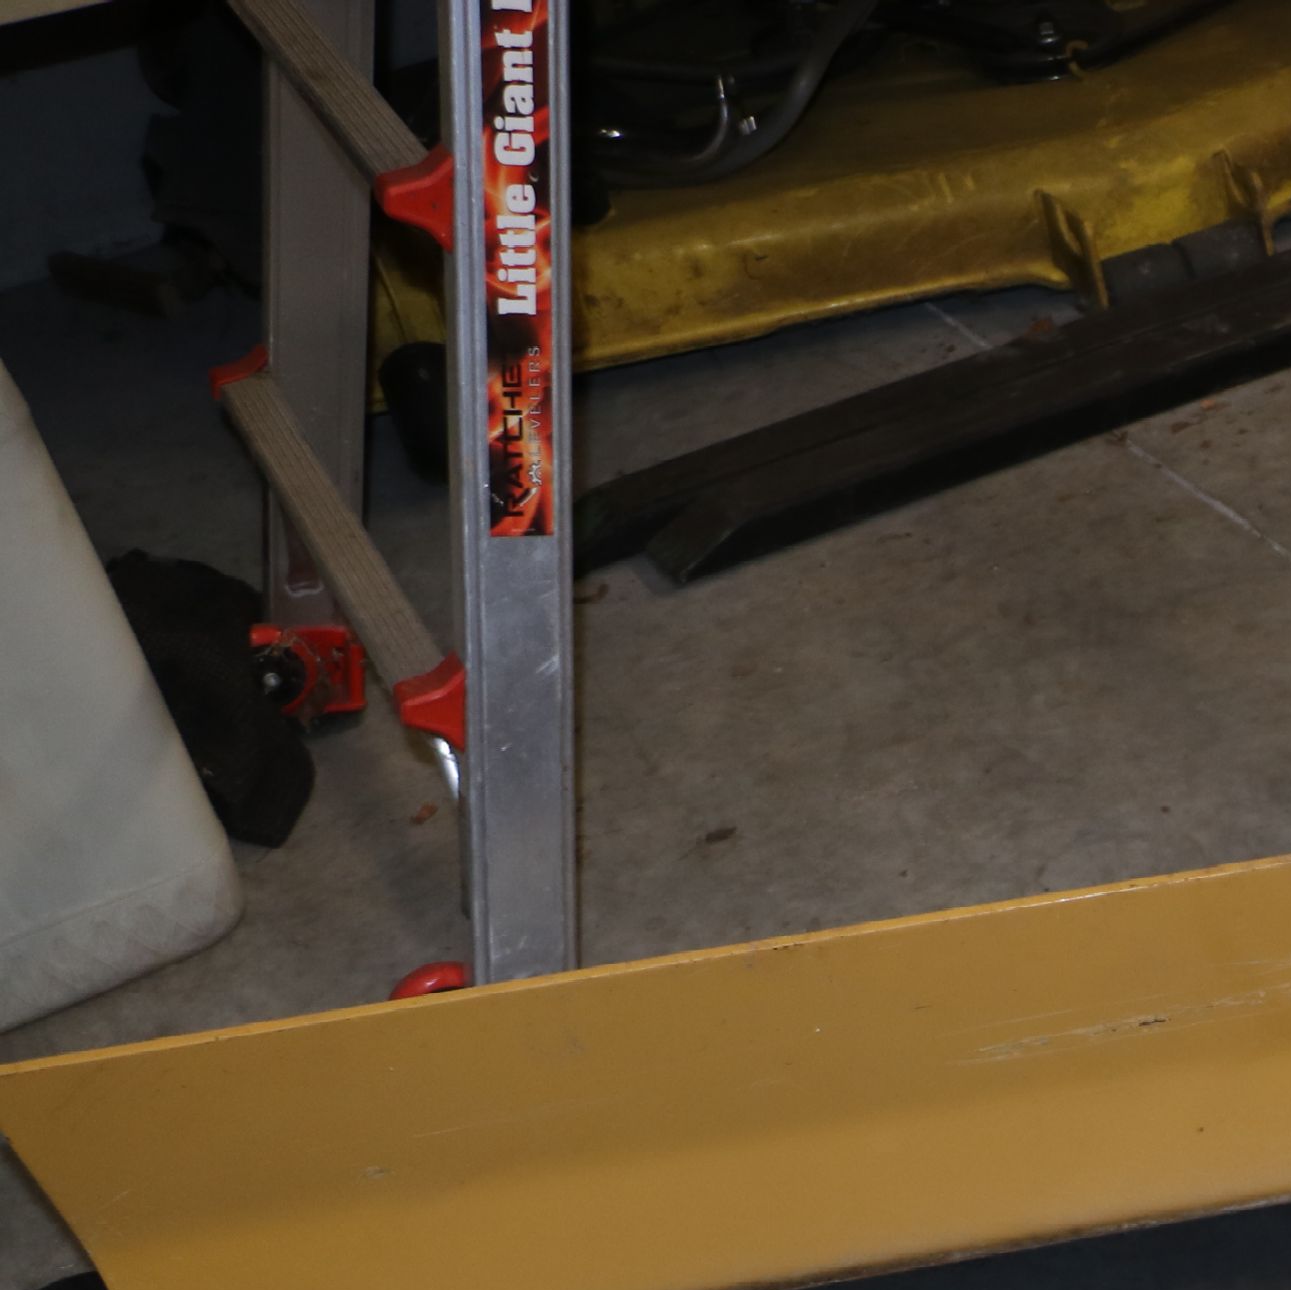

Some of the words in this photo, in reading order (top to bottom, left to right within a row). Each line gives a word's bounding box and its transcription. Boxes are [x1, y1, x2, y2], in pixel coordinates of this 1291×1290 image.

[494, 30, 536, 168] Giant
[497, 184, 537, 317] Little
[502, 358, 529, 518] RATCHE
[528, 345, 541, 459] LEVELERS
